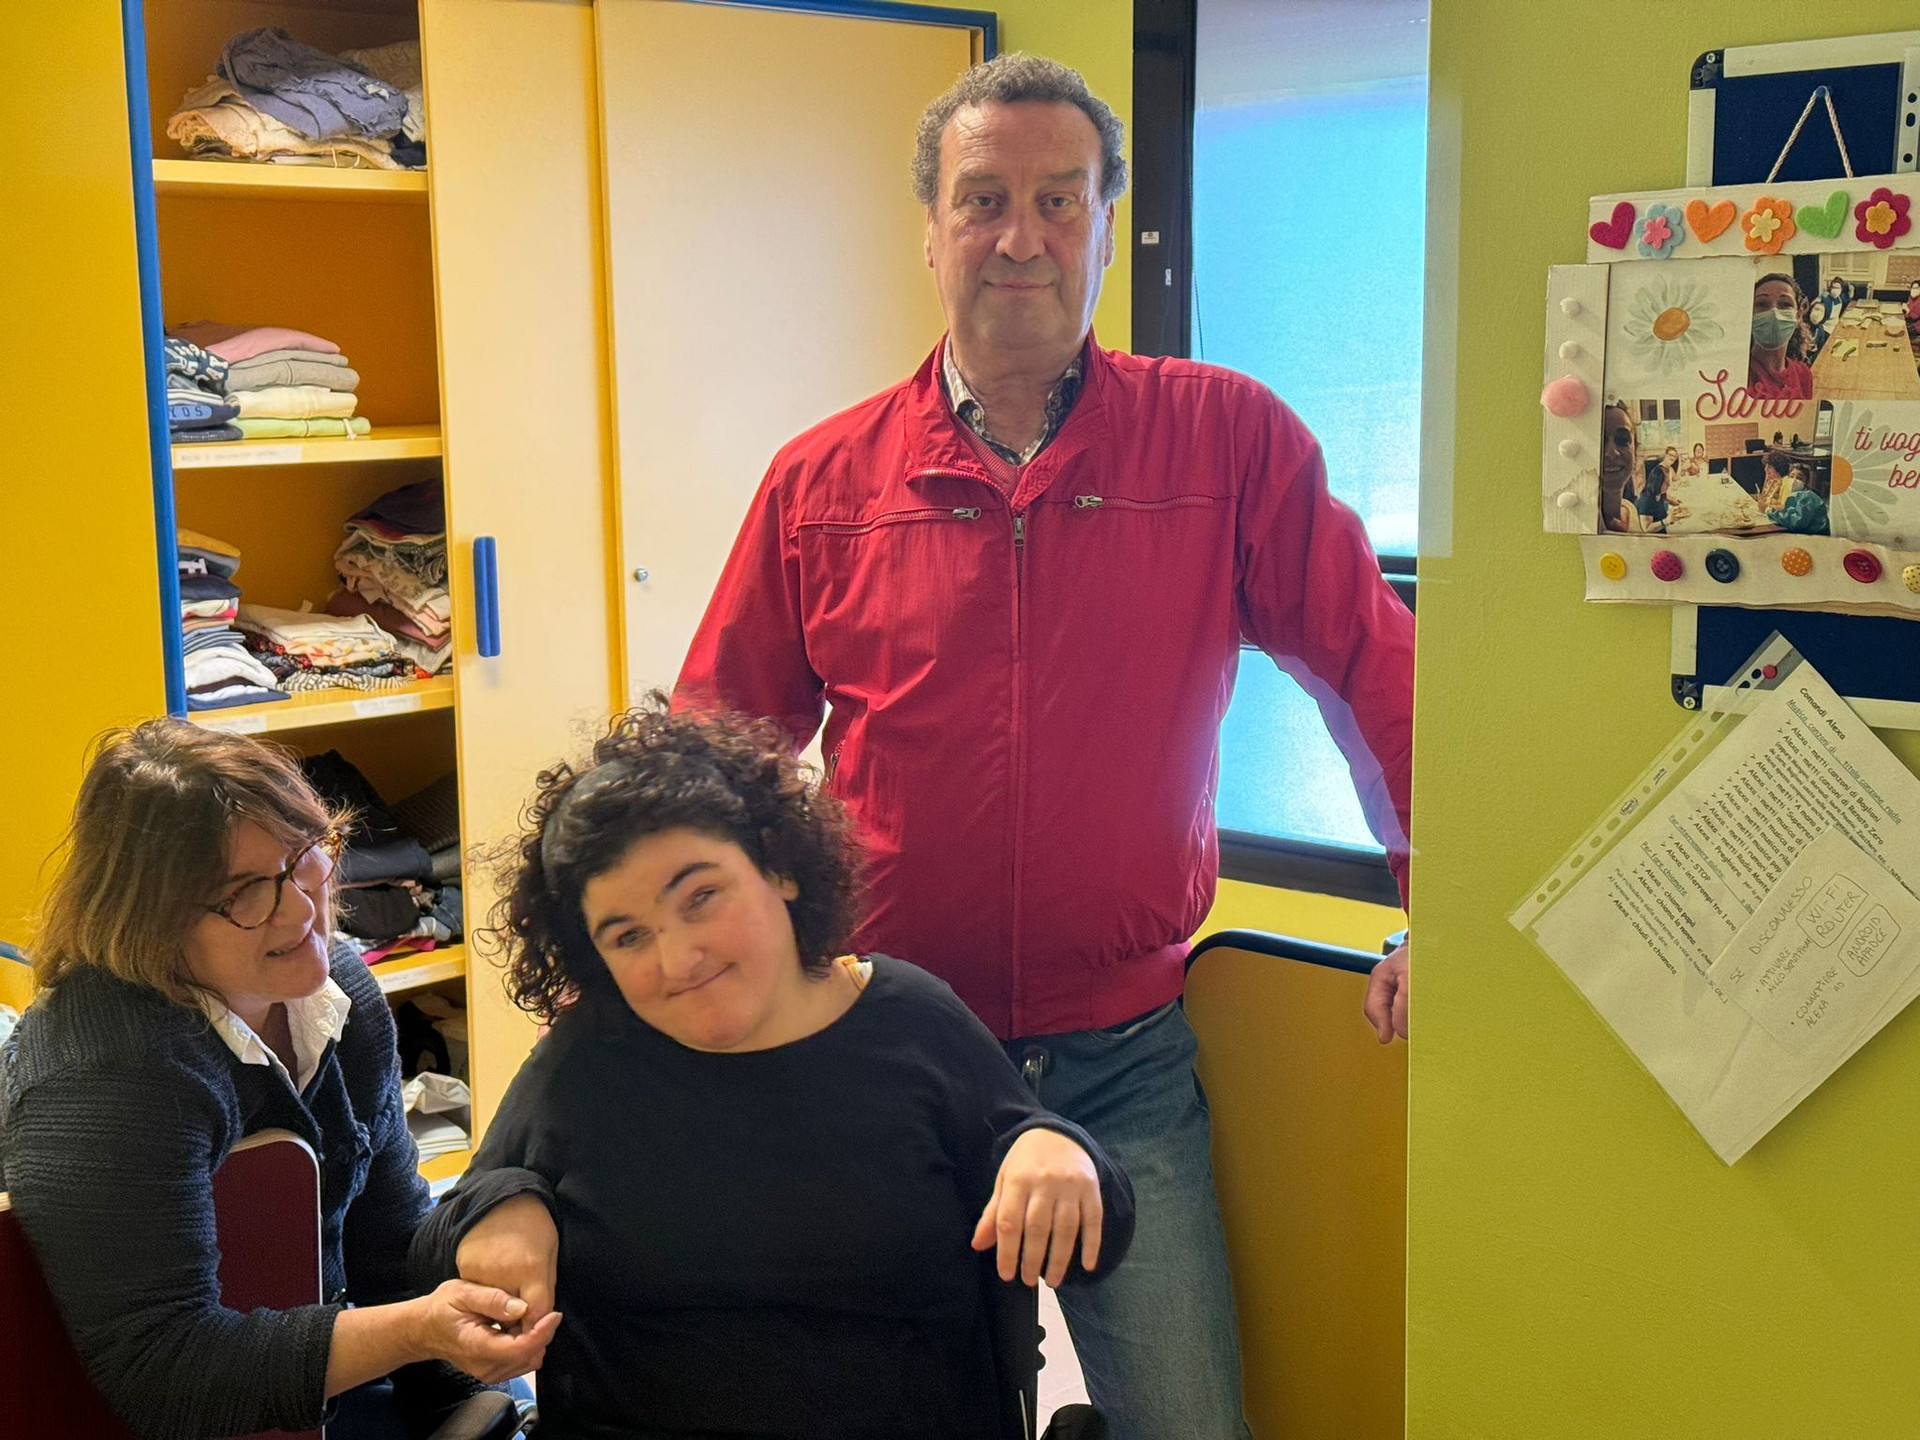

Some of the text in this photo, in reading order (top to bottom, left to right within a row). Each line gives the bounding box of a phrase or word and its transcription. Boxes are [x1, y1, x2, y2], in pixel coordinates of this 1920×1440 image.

[1696, 369, 1805, 421] Sara
[1854, 426, 1874, 451] ti
[1798, 685, 1848, 740] Comandi Alexa
[1747, 766, 1767, 788] Alexa
[1767, 789, 1786, 809] metti
[1755, 758, 1775, 780] Alexa
[1775, 781, 1794, 802] metti
[1799, 808, 1817, 827] mano
[1781, 732, 1802, 754] Alexa
[1801, 755, 1821, 776] metti
[1817, 772, 1843, 800] canzoni
[1839, 796, 1851, 807] di
[1846, 803, 1871, 830] Renato
[1866, 825, 1886, 846] Zero
[1790, 724, 1810, 746] Alexa
[1810, 747, 1830, 769] metti
[1826, 764, 1852, 792] canzoni
[1848, 787, 1859, 799] di
[1854, 795, 1882, 825] Baglioni
[1807, 721, 1831, 747] canzoni
[1827, 743, 1838, 754] di
[1842, 759, 1862, 780] titolo
[1883, 803, 1903, 824] radio
[1723, 789, 1743, 811] Alexa
[1743, 812, 1762, 832] metti
[1758, 829, 1781, 854] musica
[1731, 782, 1751, 803] Alexa
[1751, 804, 1771, 825] metti
[1767, 822, 1789, 846] musica
[1786, 843, 1796, 853] di
[1739, 774, 1759, 796] Alexa
[1759, 796, 1778, 817] metti
[1775, 814, 1798, 839] musica
[1793, 835, 1805, 846] di
[1640, 840, 1654, 854] Per
[1649, 851, 1666, 868] fare
[1672, 839, 1692, 860] Alexa
[1692, 862, 1712, 883] STOP
[1692, 820, 1711, 842] Alexa
[1712, 844, 1743, 879] Preghiera
[1700, 813, 1719, 834] Alexa
[1720, 835, 1738, 855] metti
[1735, 853, 1754, 873] Radio
[1750, 870, 1772, 894] Monte
[1707, 805, 1728, 827] Alexa
[1727, 827, 1746, 848] metti
[1745, 849, 1767, 873] rumori
[1716, 797, 1735, 819] Alexa
[1735, 819, 1755, 840] metti
[1751, 837, 1773, 862] musica
[1768, 859, 1783, 875] pop
[1636, 874, 1655, 895] Alexa
[1644, 866, 1663, 887] Alexa
[1662, 889, 1685, 913] chiama
[1664, 847, 1683, 868] Alexa
[1682, 869, 1715, 905] interrompi
[1711, 901, 1724, 915] tra
[1804, 880, 1843, 926] WI-FI
[1612, 897, 1631, 918] Alexa
[1630, 919, 1650, 941] chiudi
[1654, 896, 1677, 921] chiama
[1672, 917, 1683, 927] la
[1728, 870, 1815, 985] SE DISCONNESSO
[1812, 884, 1862, 942] ROUTER
[1646, 938, 1656, 948] la
[1650, 945, 1679, 976] chiamata
[1677, 925, 1697, 946] nonna
[1842, 912, 1883, 961] ANDROID
[1802, 996, 1832, 1031] ALEXA
